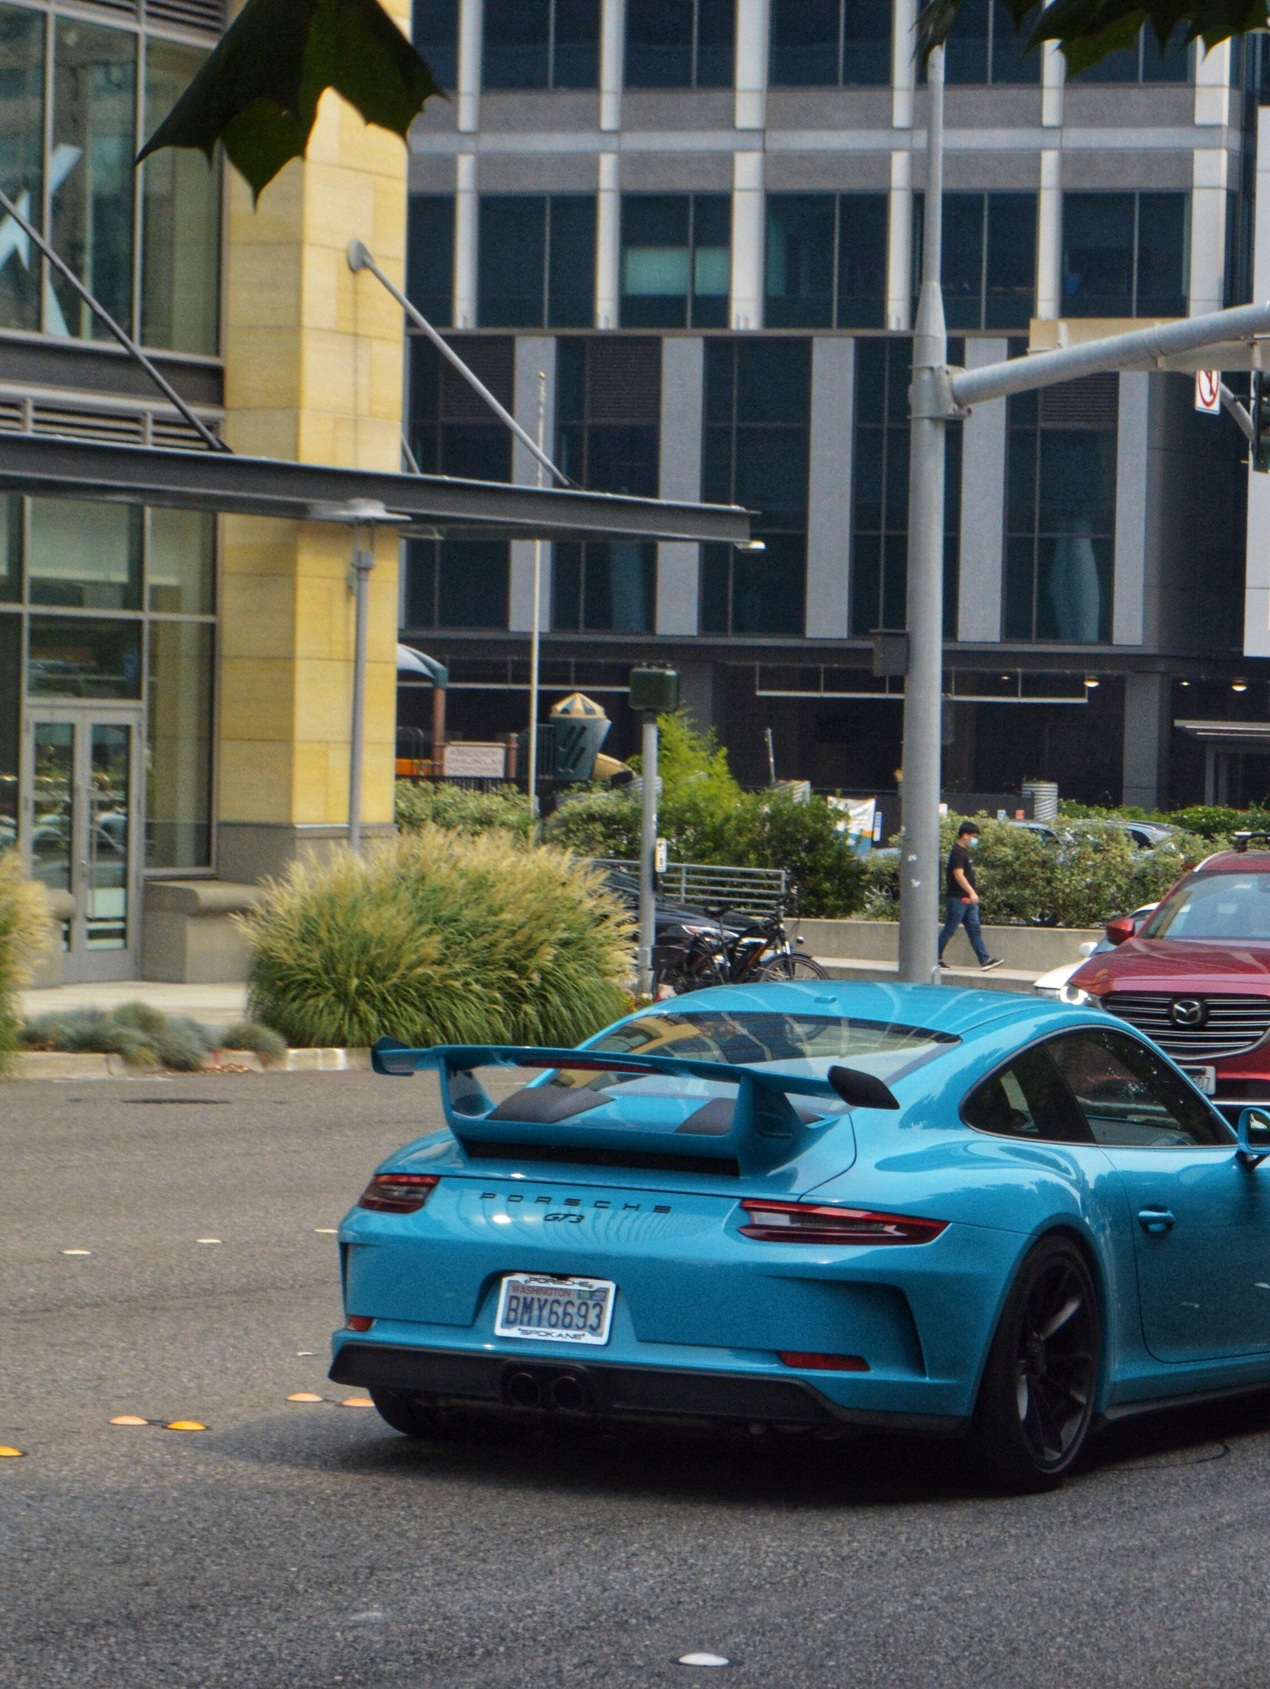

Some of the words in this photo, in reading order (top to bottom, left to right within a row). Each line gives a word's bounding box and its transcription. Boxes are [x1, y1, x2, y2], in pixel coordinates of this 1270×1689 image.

[479, 1192, 672, 1213] PORSCHE
[543, 1212, 585, 1224] GT3
[511, 1285, 571, 1297] WASHINGTON
[505, 1295, 604, 1331] BMY6693
